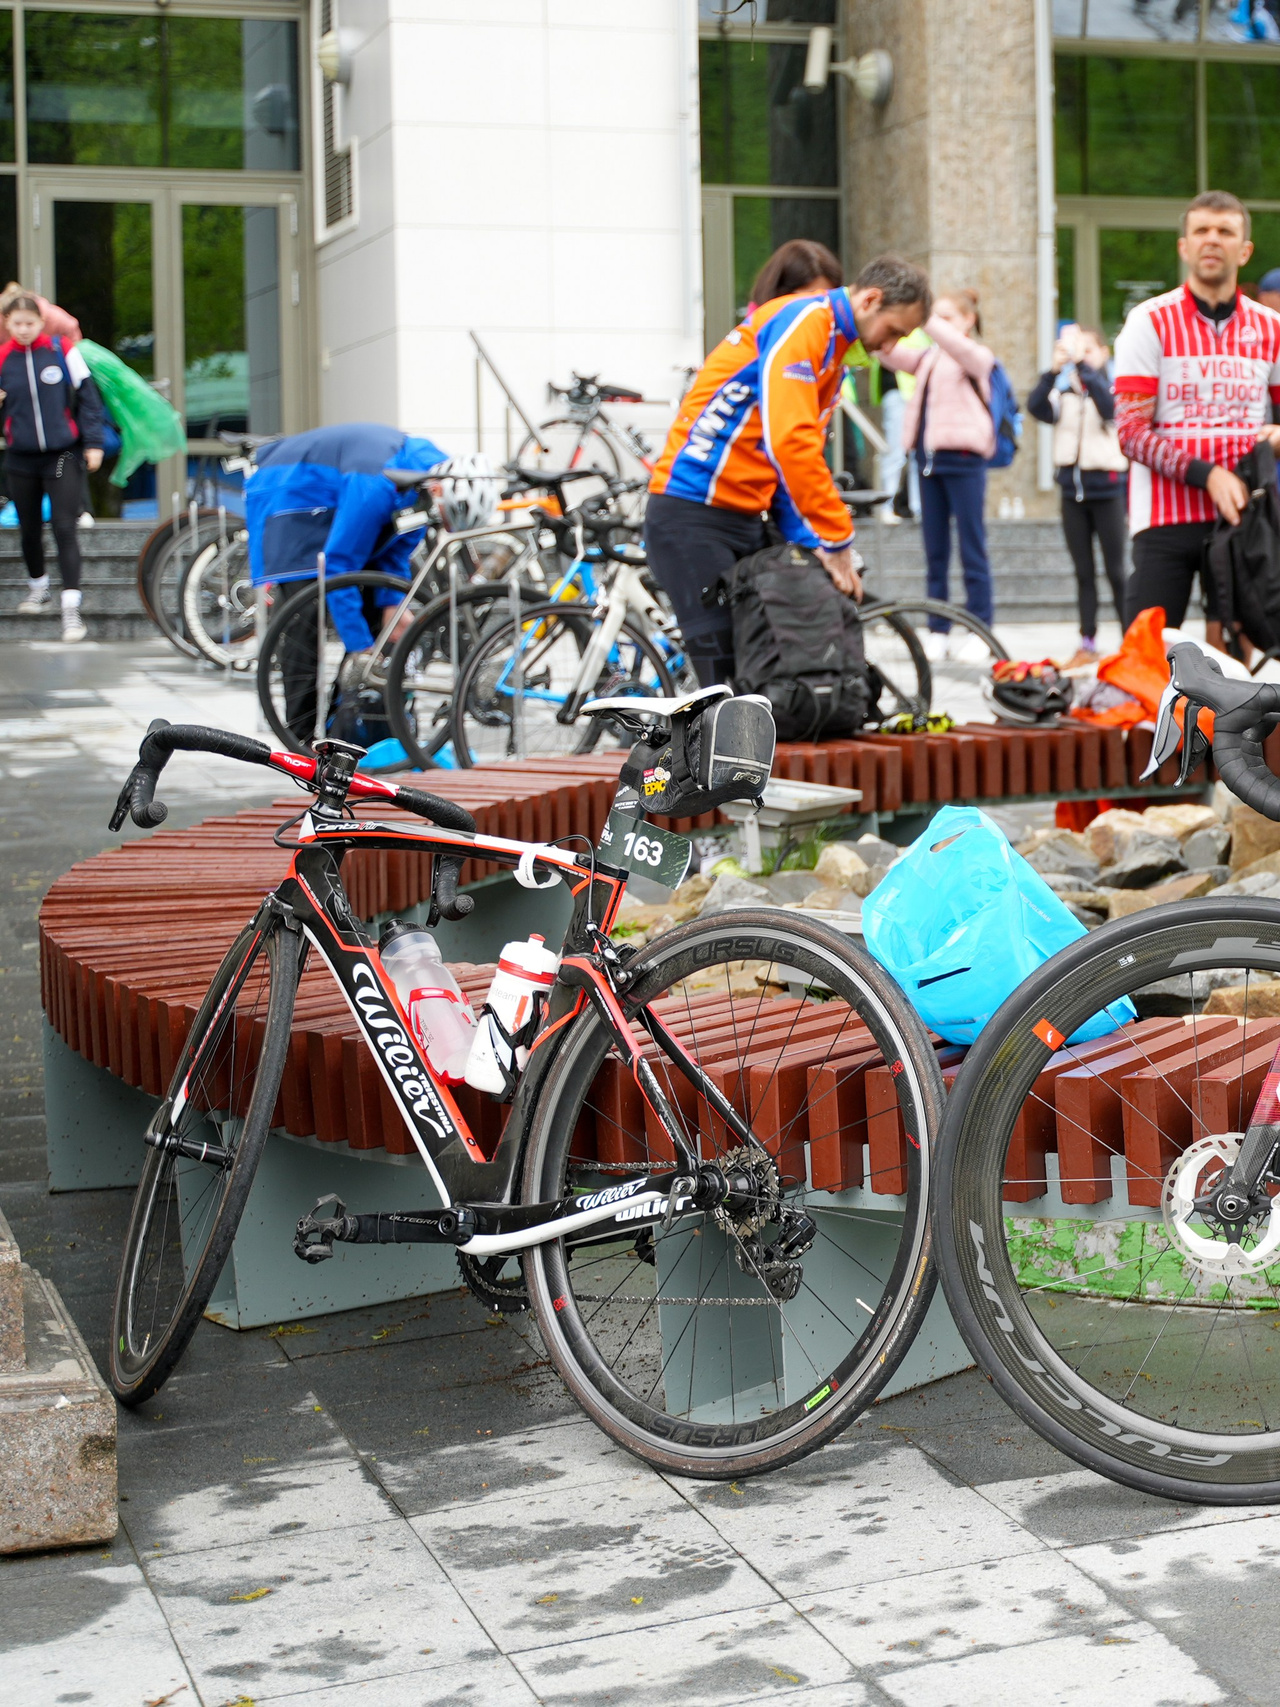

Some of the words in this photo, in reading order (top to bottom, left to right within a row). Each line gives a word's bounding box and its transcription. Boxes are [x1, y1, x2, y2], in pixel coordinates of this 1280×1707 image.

[1167, 384, 1202, 401] DEL
[644, 779, 667, 796] EPIC
[624, 832, 664, 866] 163
[353, 963, 446, 1138] Wilier
[419, 1072, 454, 1134] TRIESTINA
[576, 1178, 647, 1210] Wilier
[389, 1214, 438, 1225] ULTEGRA
[970, 1219, 1233, 1467] FULCRUM
